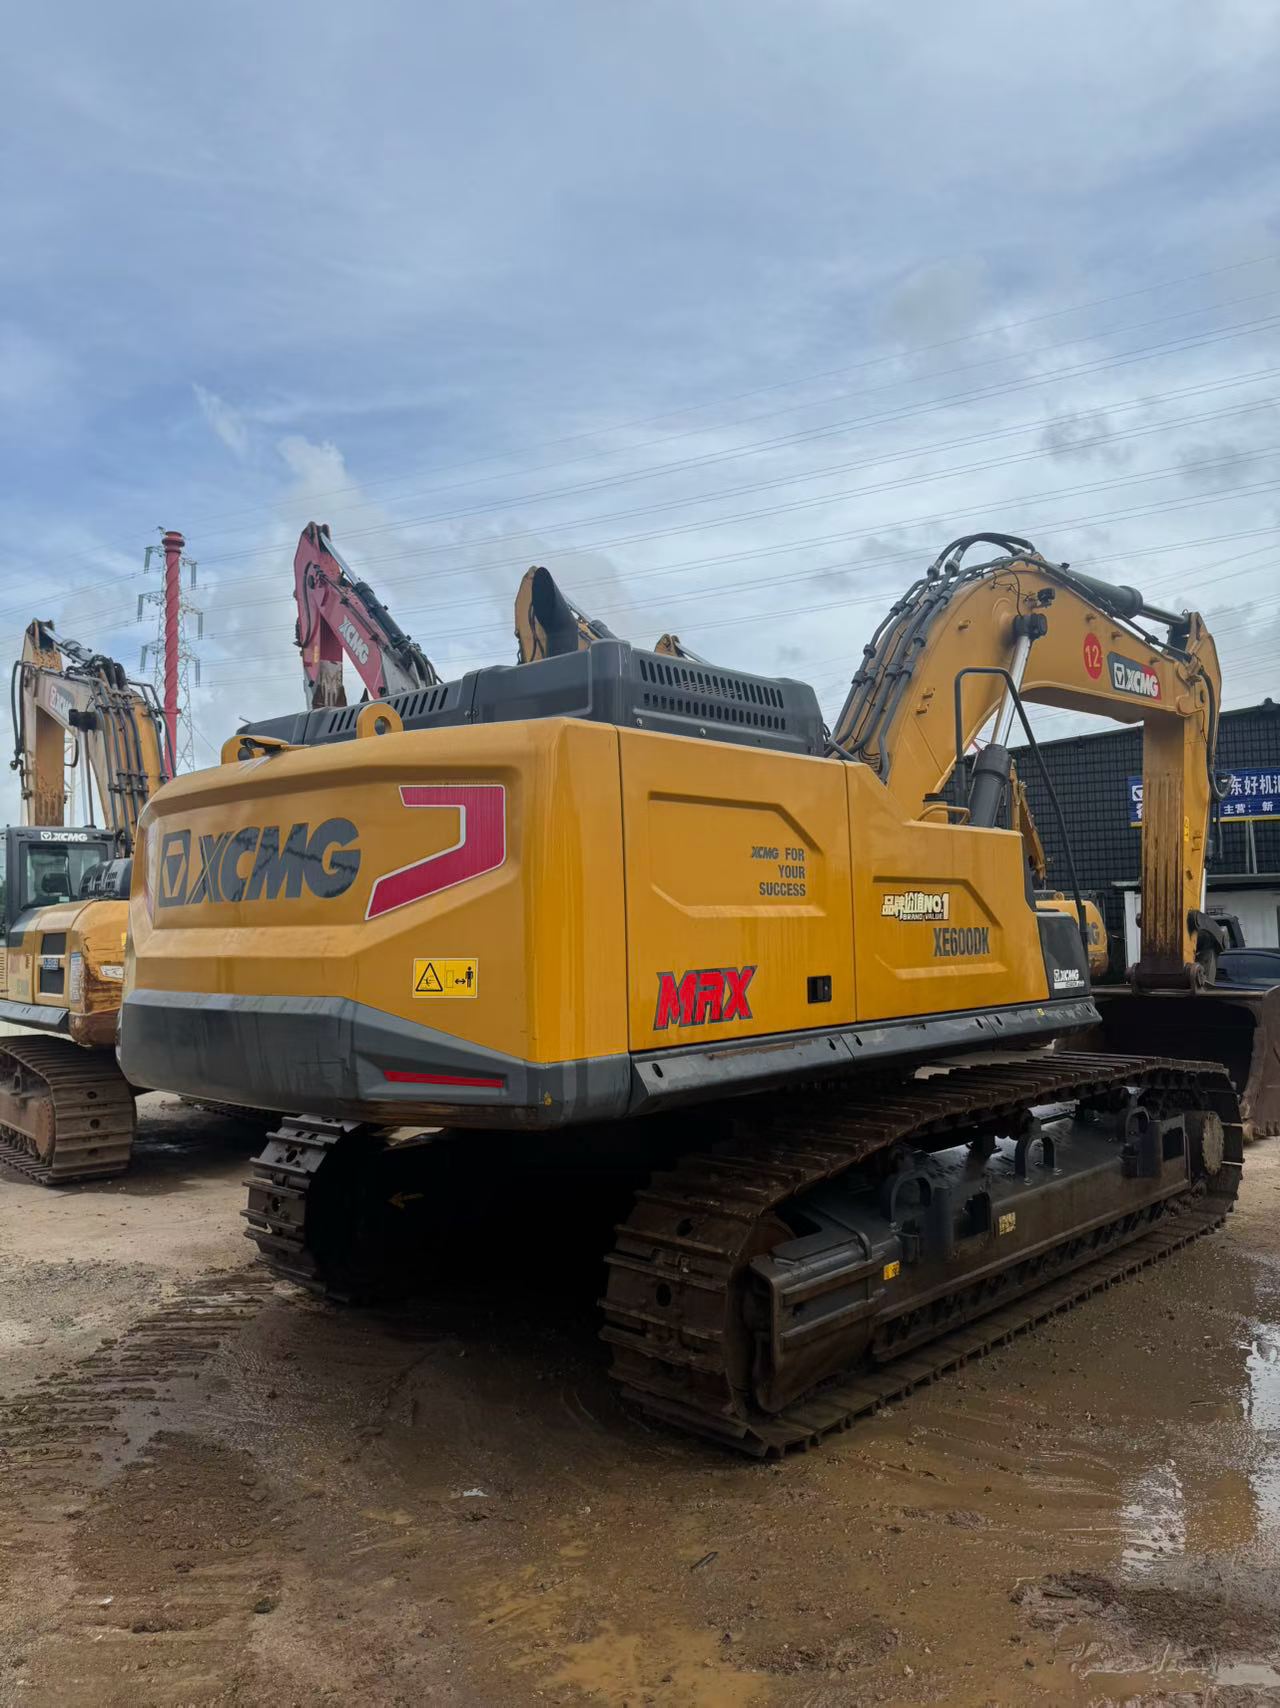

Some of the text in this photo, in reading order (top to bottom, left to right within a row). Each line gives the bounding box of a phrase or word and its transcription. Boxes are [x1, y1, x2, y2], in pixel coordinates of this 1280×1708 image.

[338, 616, 369, 665] XCMG
[1085, 645, 1100, 668] 12
[1125, 668, 1159, 697] XCMG
[51, 832, 88, 842] XCMG
[185, 817, 361, 904] XCMG
[751, 846, 805, 862] XCMG FOR
[778, 864, 806, 880] YOUR
[759, 881, 806, 897] SUCCESS
[932, 927, 991, 957] XE600DK
[1060, 969, 1080, 981] XCMG
[653, 965, 758, 1031] MAX
